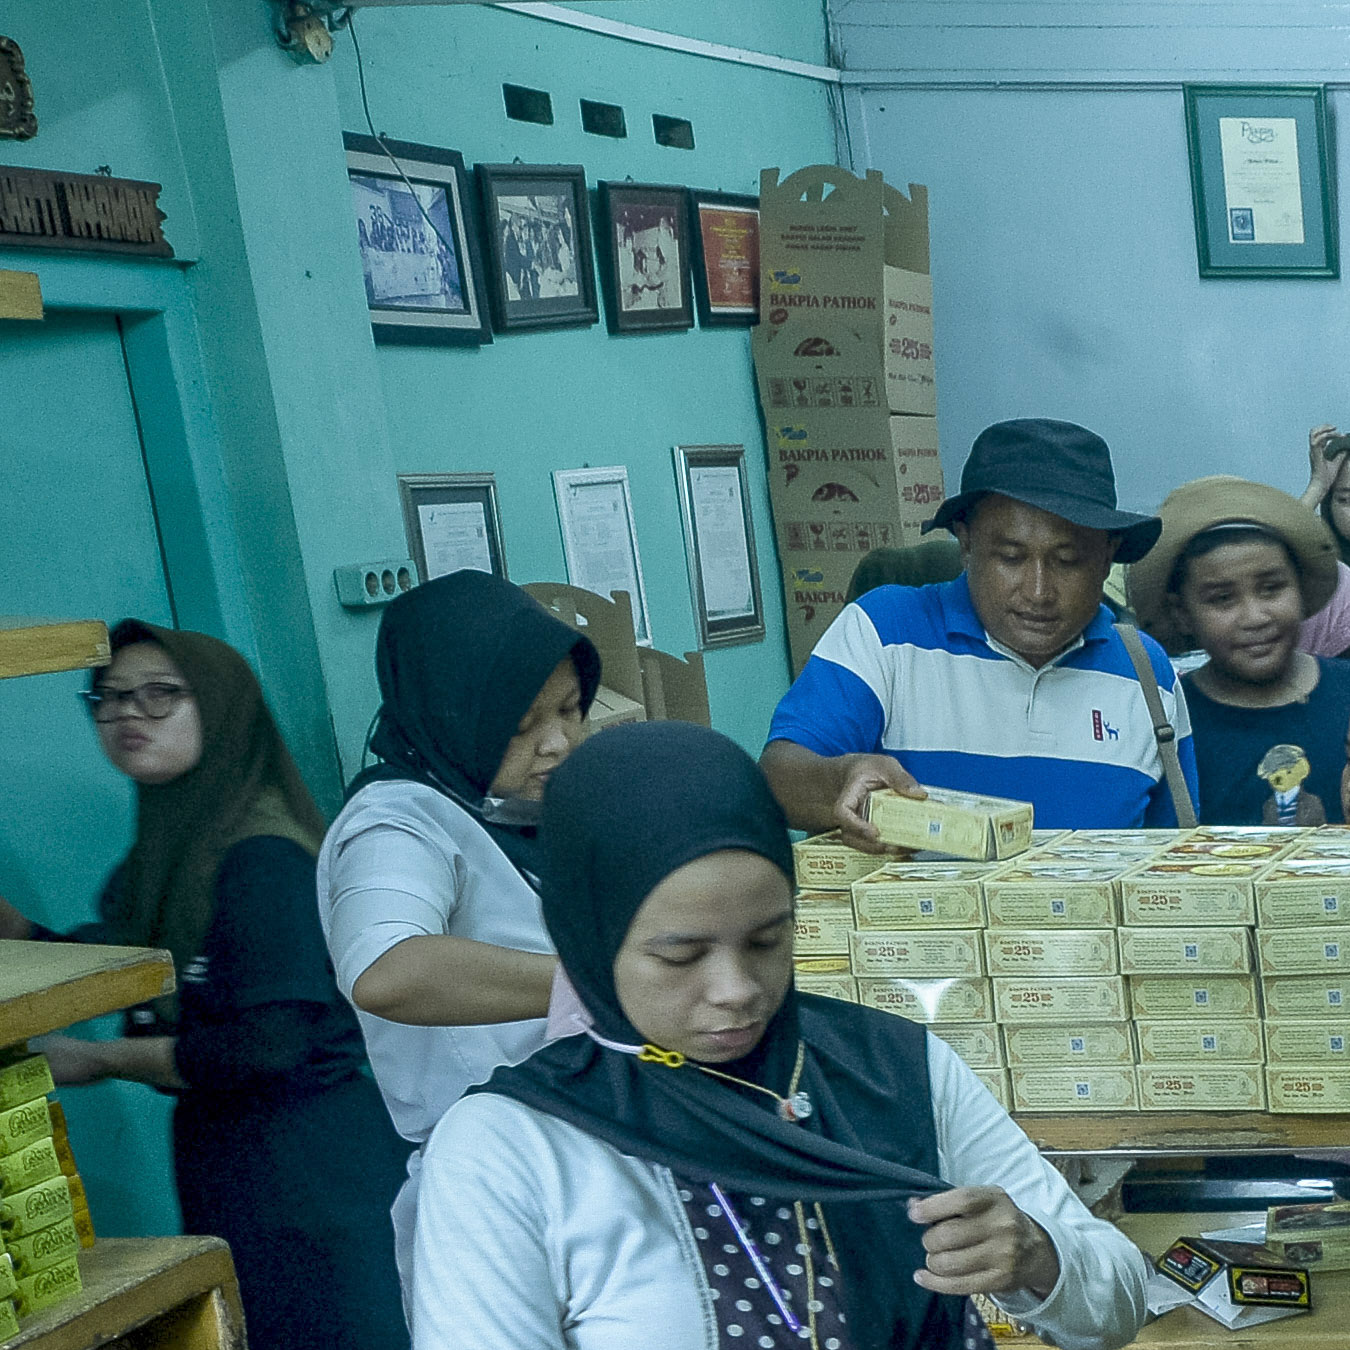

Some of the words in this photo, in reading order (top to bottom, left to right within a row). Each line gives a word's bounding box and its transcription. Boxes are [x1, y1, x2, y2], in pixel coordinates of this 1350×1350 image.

[770, 293, 820, 308] BAKPIA
[822, 295, 877, 310] PATHOK
[779, 450, 829, 462] BAKPIA
[832, 450, 887, 462] PATHOK
[795, 591, 846, 604] BAKPIA
[819, 860, 834, 870] 25
[1151, 895, 1168, 905] 25
[878, 946, 895, 957] 25
[1014, 946, 1031, 956] 25
[887, 993, 903, 1003] 25
[1023, 992, 1040, 1002] 25
[1165, 1080, 1182, 1090] 25
[1295, 1082, 1311, 1092] 25
